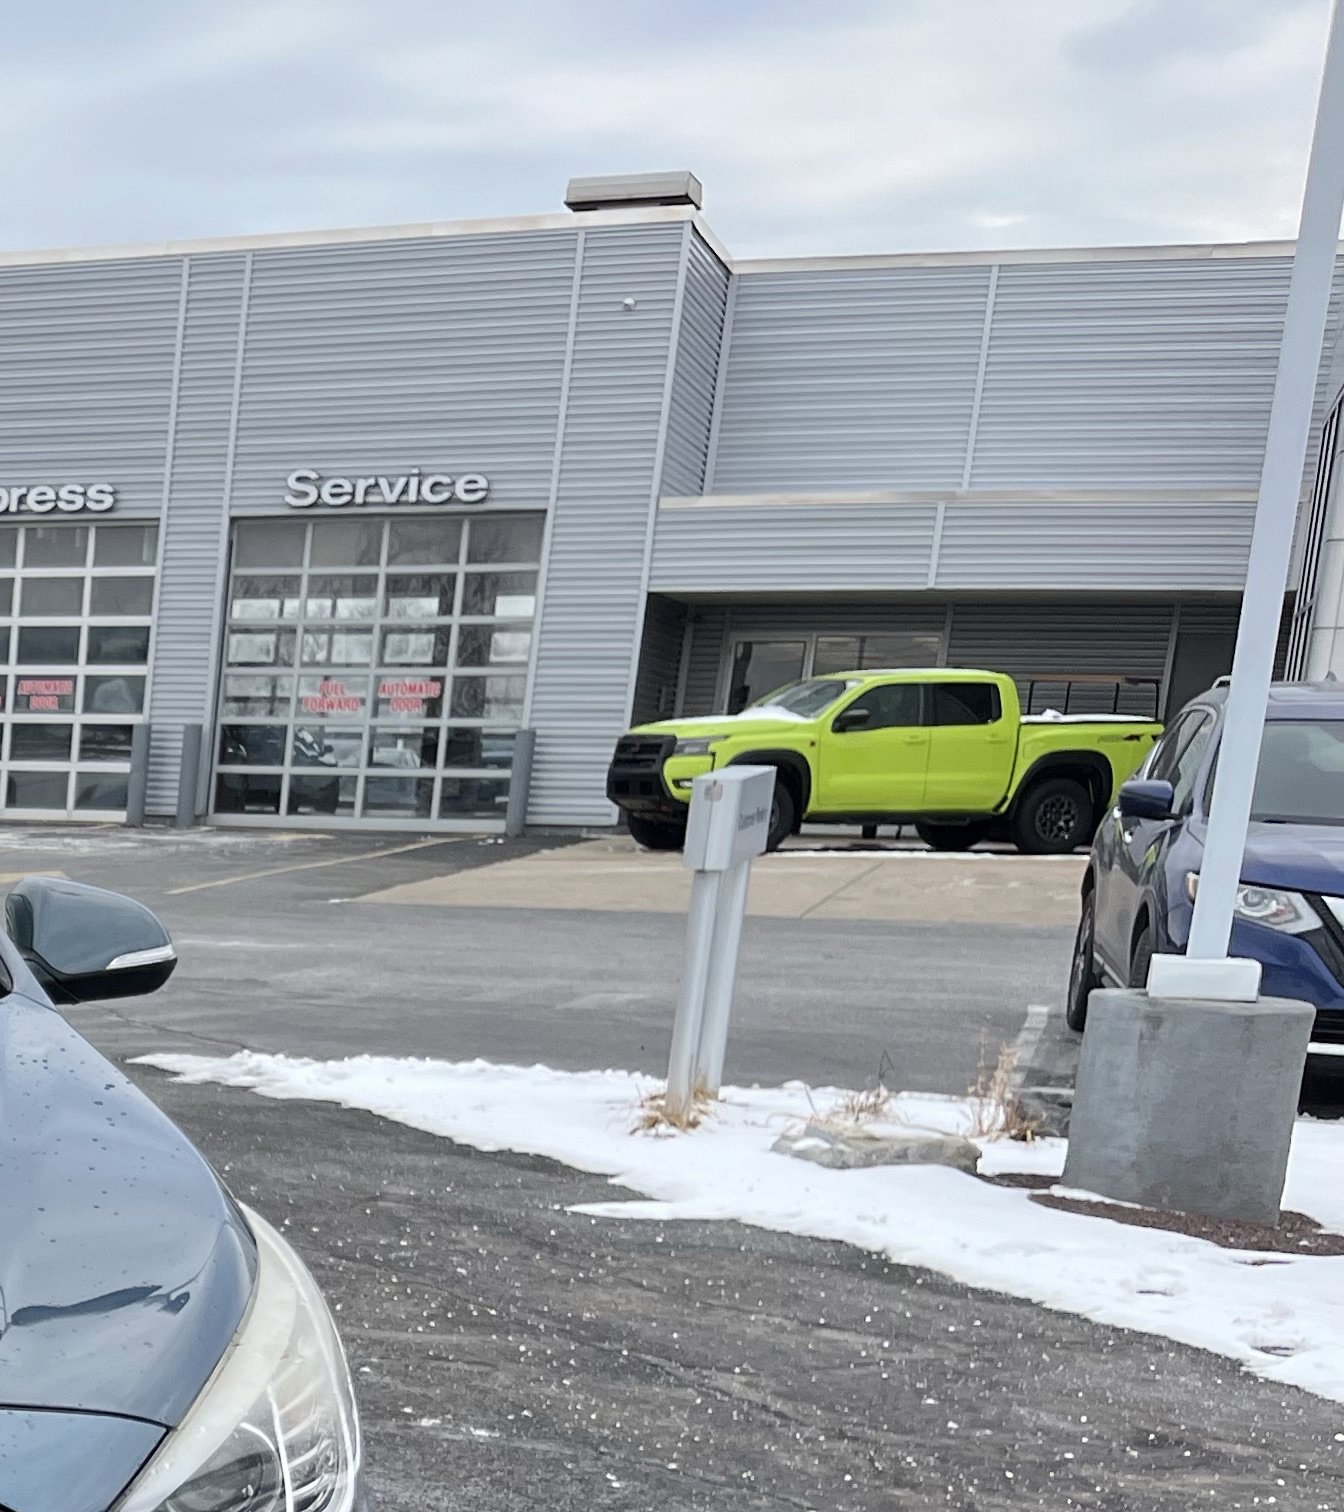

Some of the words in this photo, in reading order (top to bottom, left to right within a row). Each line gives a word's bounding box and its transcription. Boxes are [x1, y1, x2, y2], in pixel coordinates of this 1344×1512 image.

[284, 467, 489, 507] Service
[378, 681, 441, 697] AUTOMATIC
[303, 697, 361, 712] FORWARD
